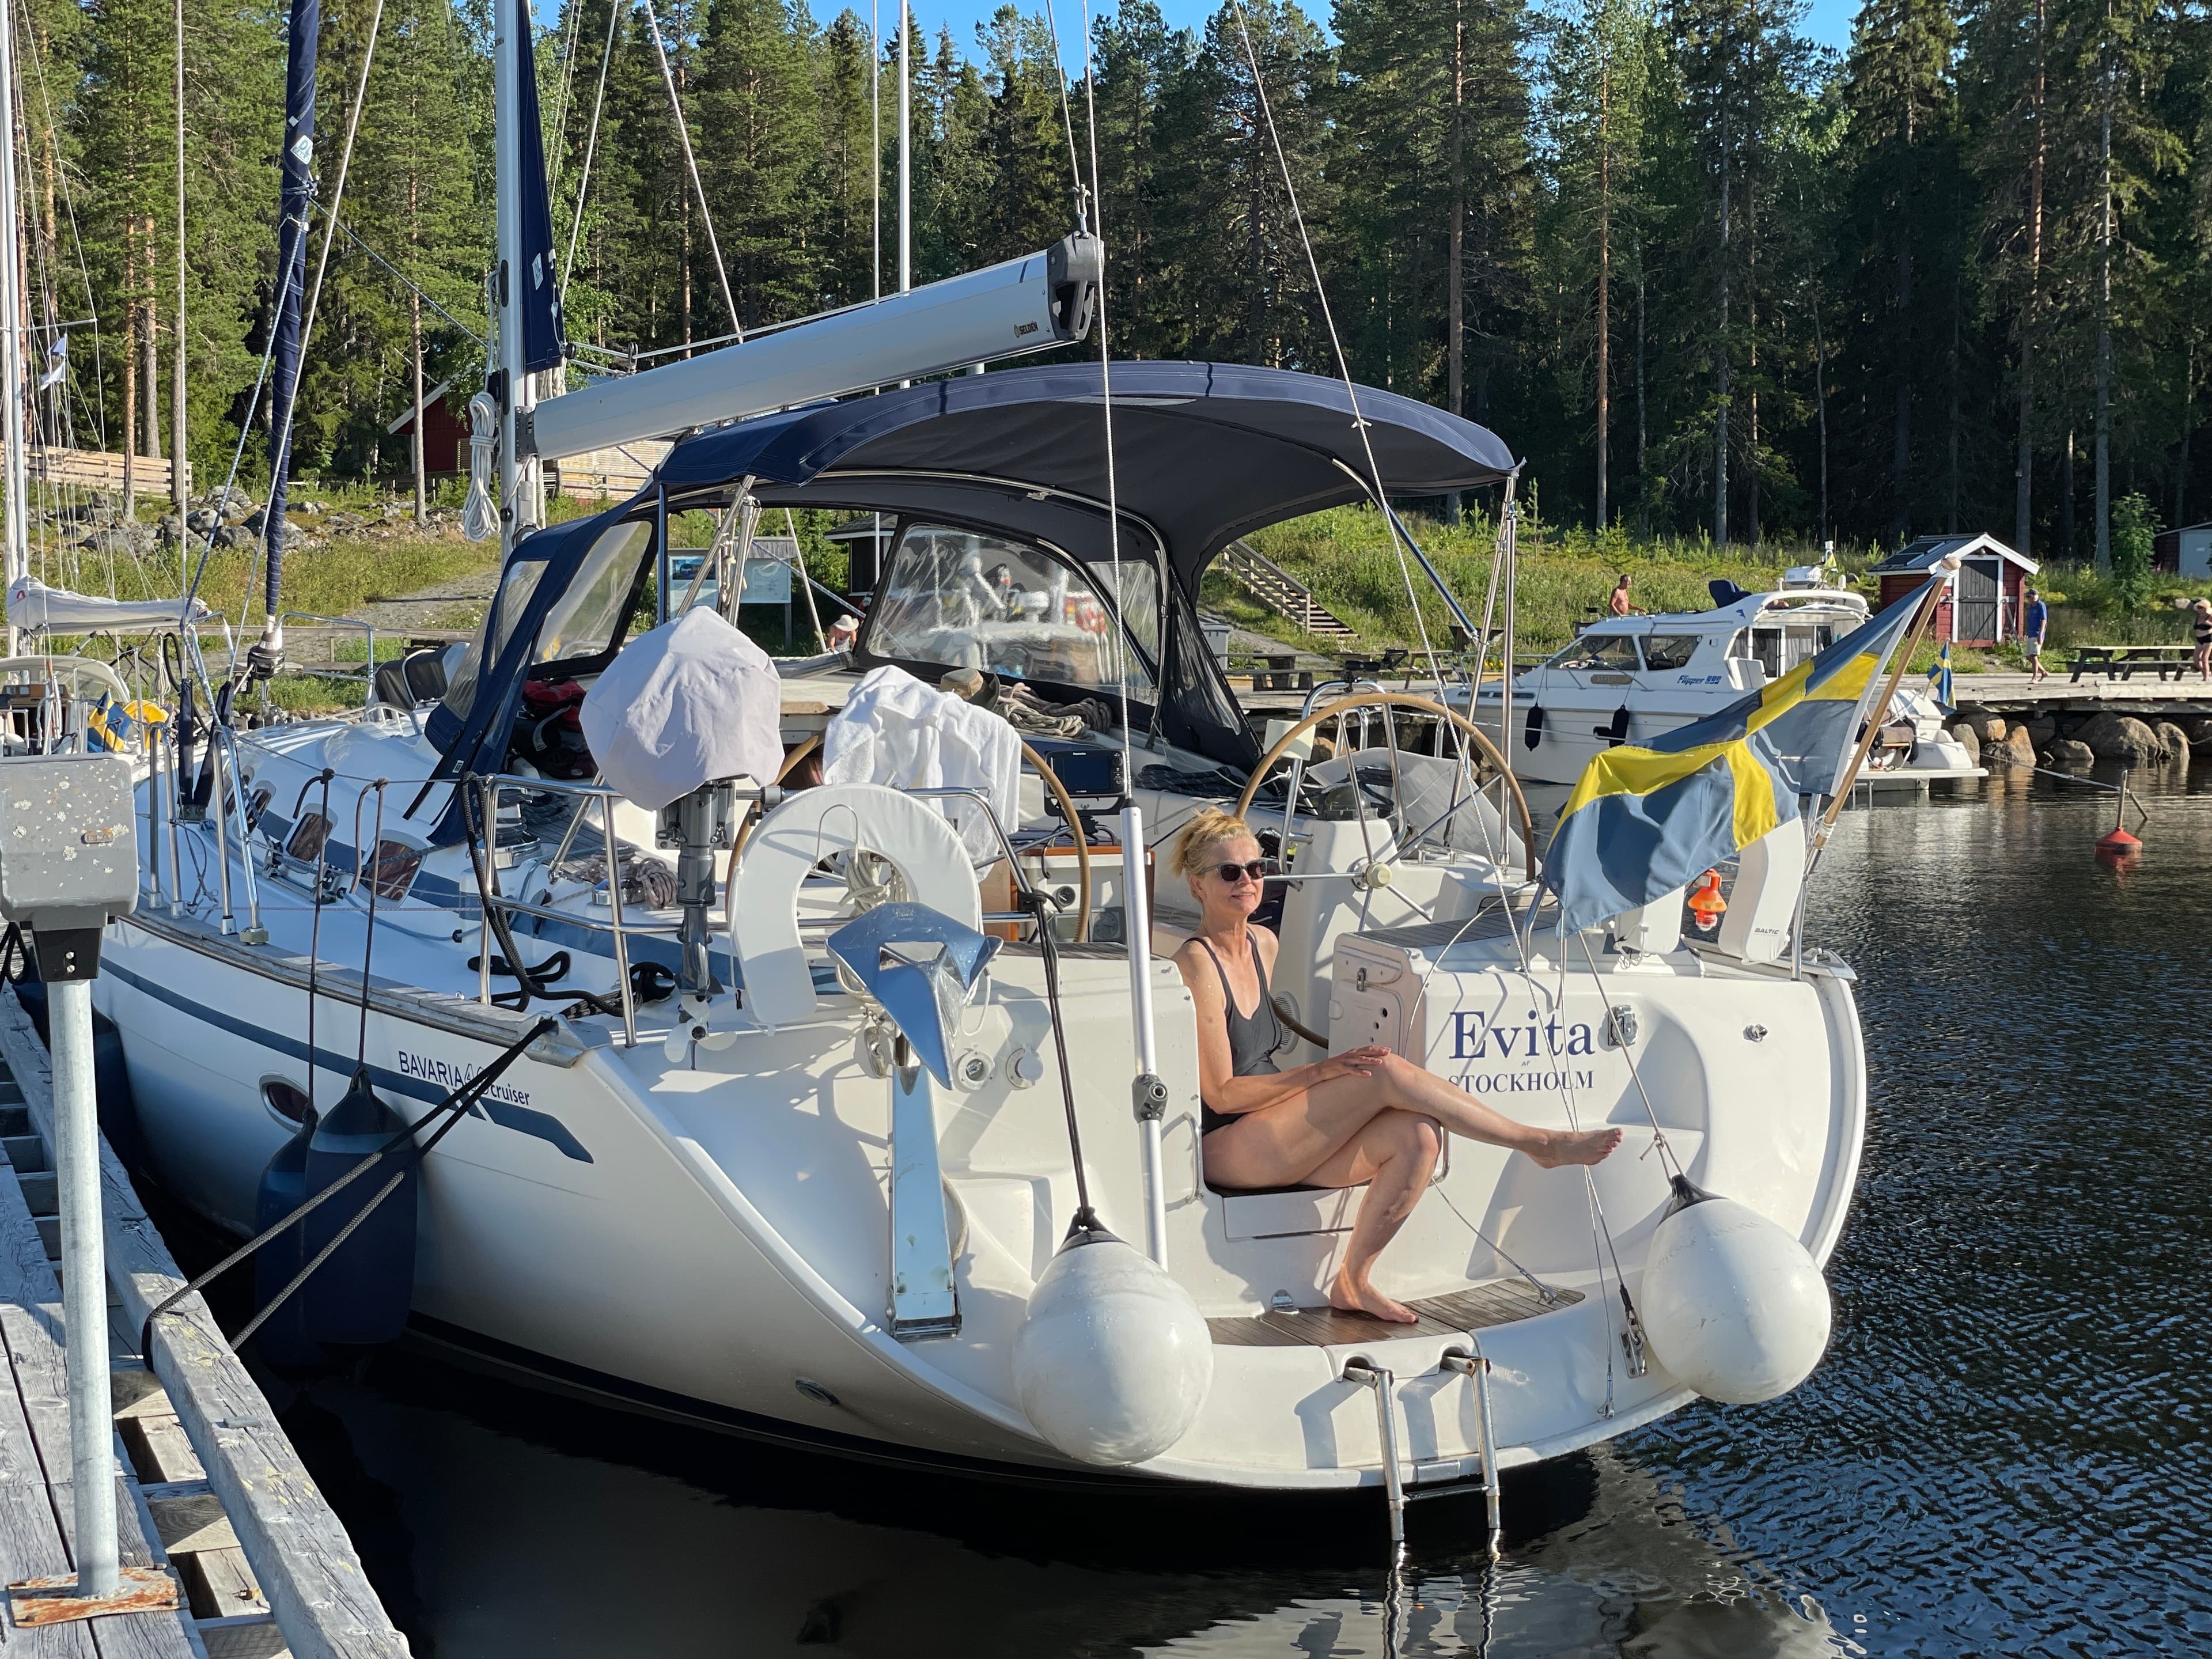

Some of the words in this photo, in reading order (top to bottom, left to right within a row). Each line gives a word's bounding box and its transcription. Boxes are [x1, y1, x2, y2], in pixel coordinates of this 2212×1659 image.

[1019, 320, 1038, 335] SELDÉN
[1677, 675, 1705, 685] Flipper
[1449, 1010, 1595, 1059] Evita
[399, 1051, 464, 1087] BAVARIA
[491, 1083, 530, 1105] cruiser
